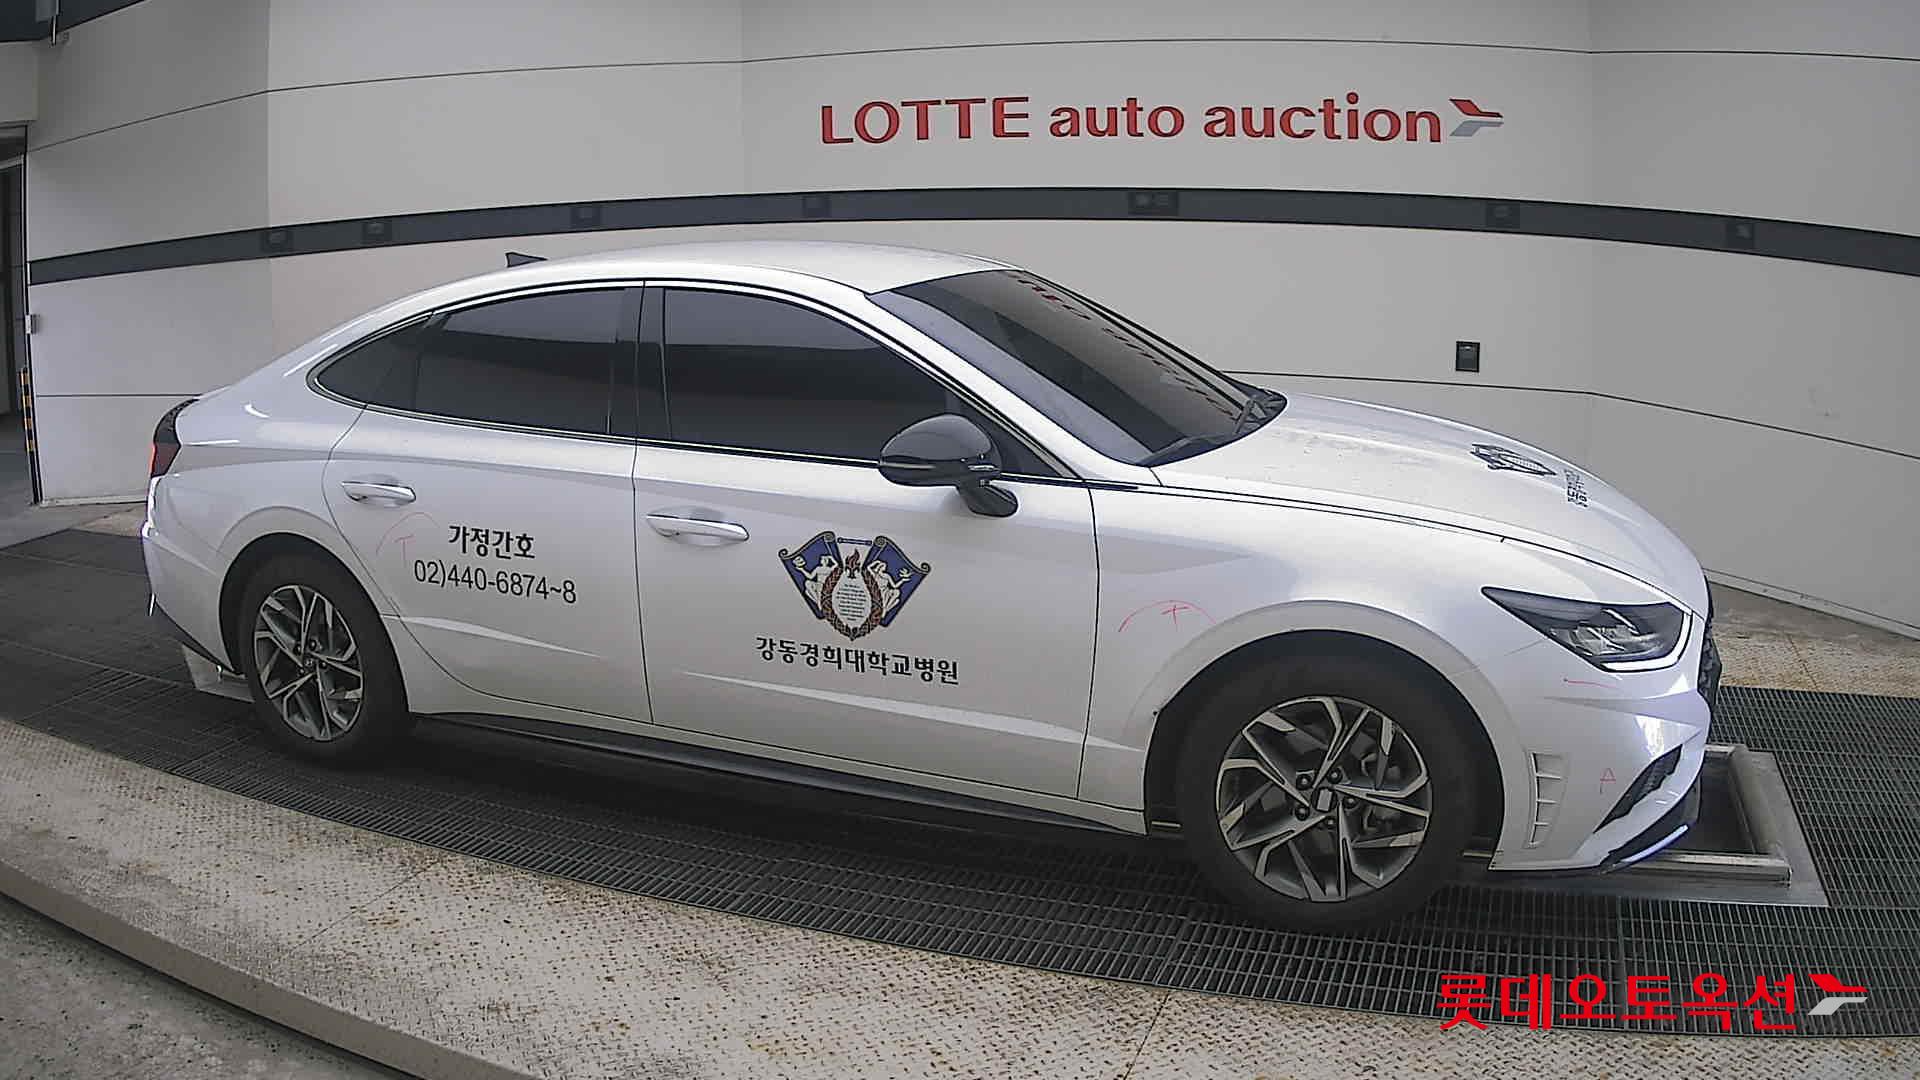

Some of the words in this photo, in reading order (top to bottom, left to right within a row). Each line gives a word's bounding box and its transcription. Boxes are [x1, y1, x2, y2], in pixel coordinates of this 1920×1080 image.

[821, 96, 1030, 145] LOTTE
[1048, 97, 1186, 138] auto
[1204, 92, 1443, 143] auction
[448, 525, 536, 560] 가정간호
[414, 559, 577, 604] 02)440-6874~8
[756, 637, 960, 685] 강동경희대학교병원
